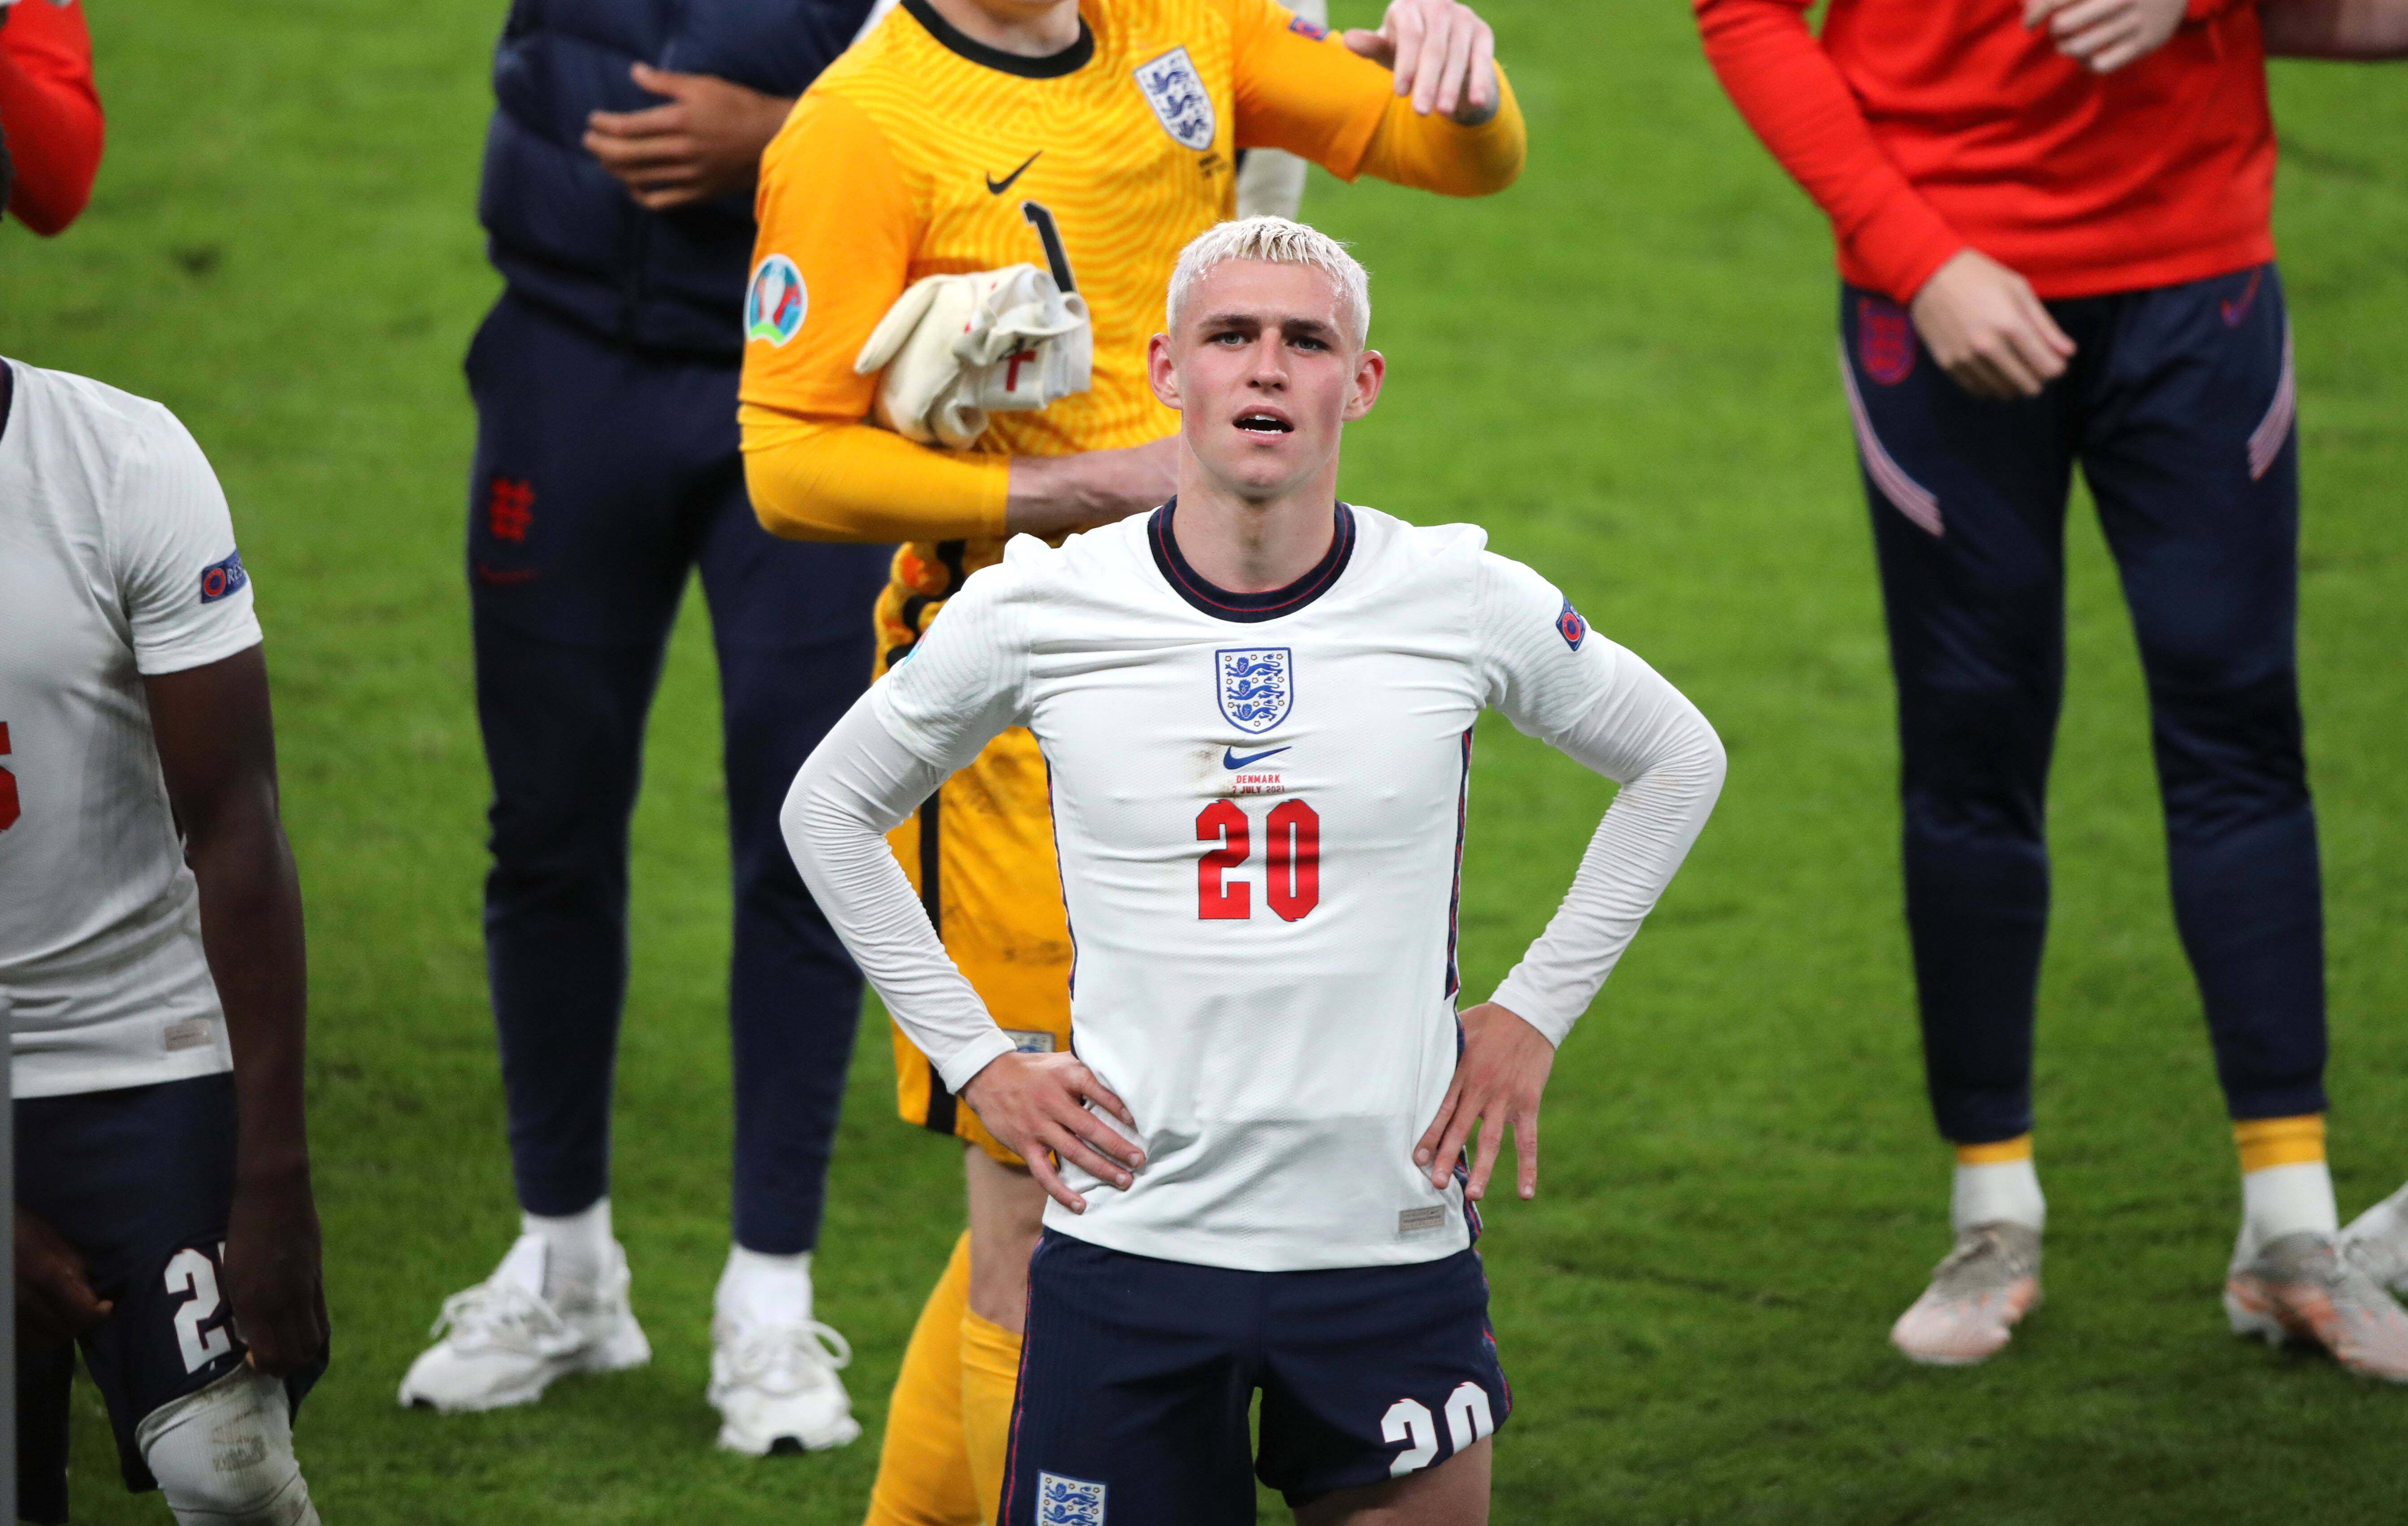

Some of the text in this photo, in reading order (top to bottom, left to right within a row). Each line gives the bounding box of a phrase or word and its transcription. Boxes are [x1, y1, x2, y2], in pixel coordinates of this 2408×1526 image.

[1021, 200, 1078, 293] 1
[1232, 785, 1285, 794] 7 JULY 2021
[1237, 774, 1281, 784] DENMARK
[1196, 799, 1319, 922] 20
